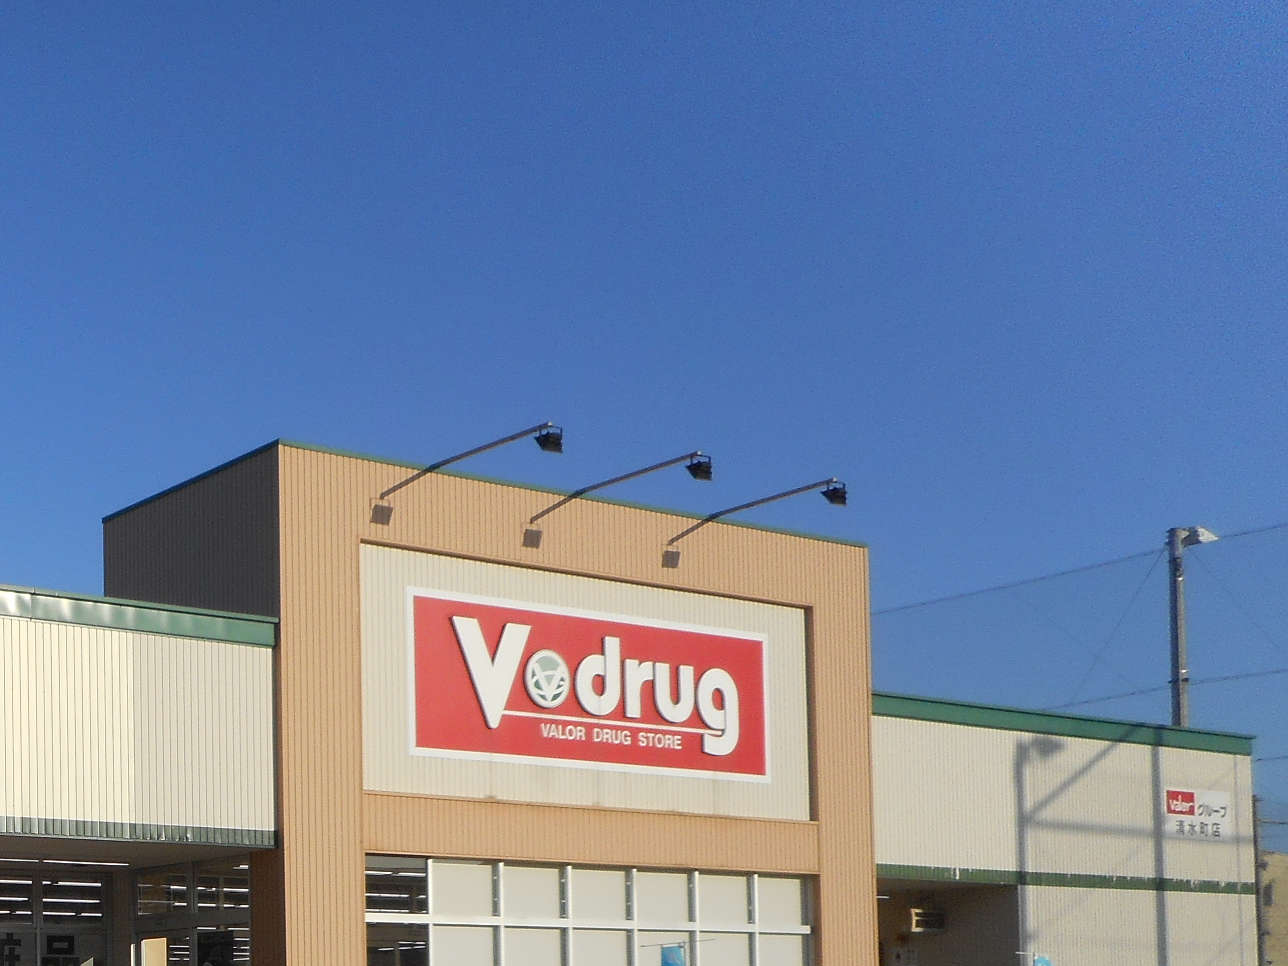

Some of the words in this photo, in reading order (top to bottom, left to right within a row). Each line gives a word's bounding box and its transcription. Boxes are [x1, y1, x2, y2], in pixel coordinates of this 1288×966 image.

[540, 723, 586, 741] VALOR
[593, 728, 632, 745] DRUG
[638, 732, 682, 750] STORE
